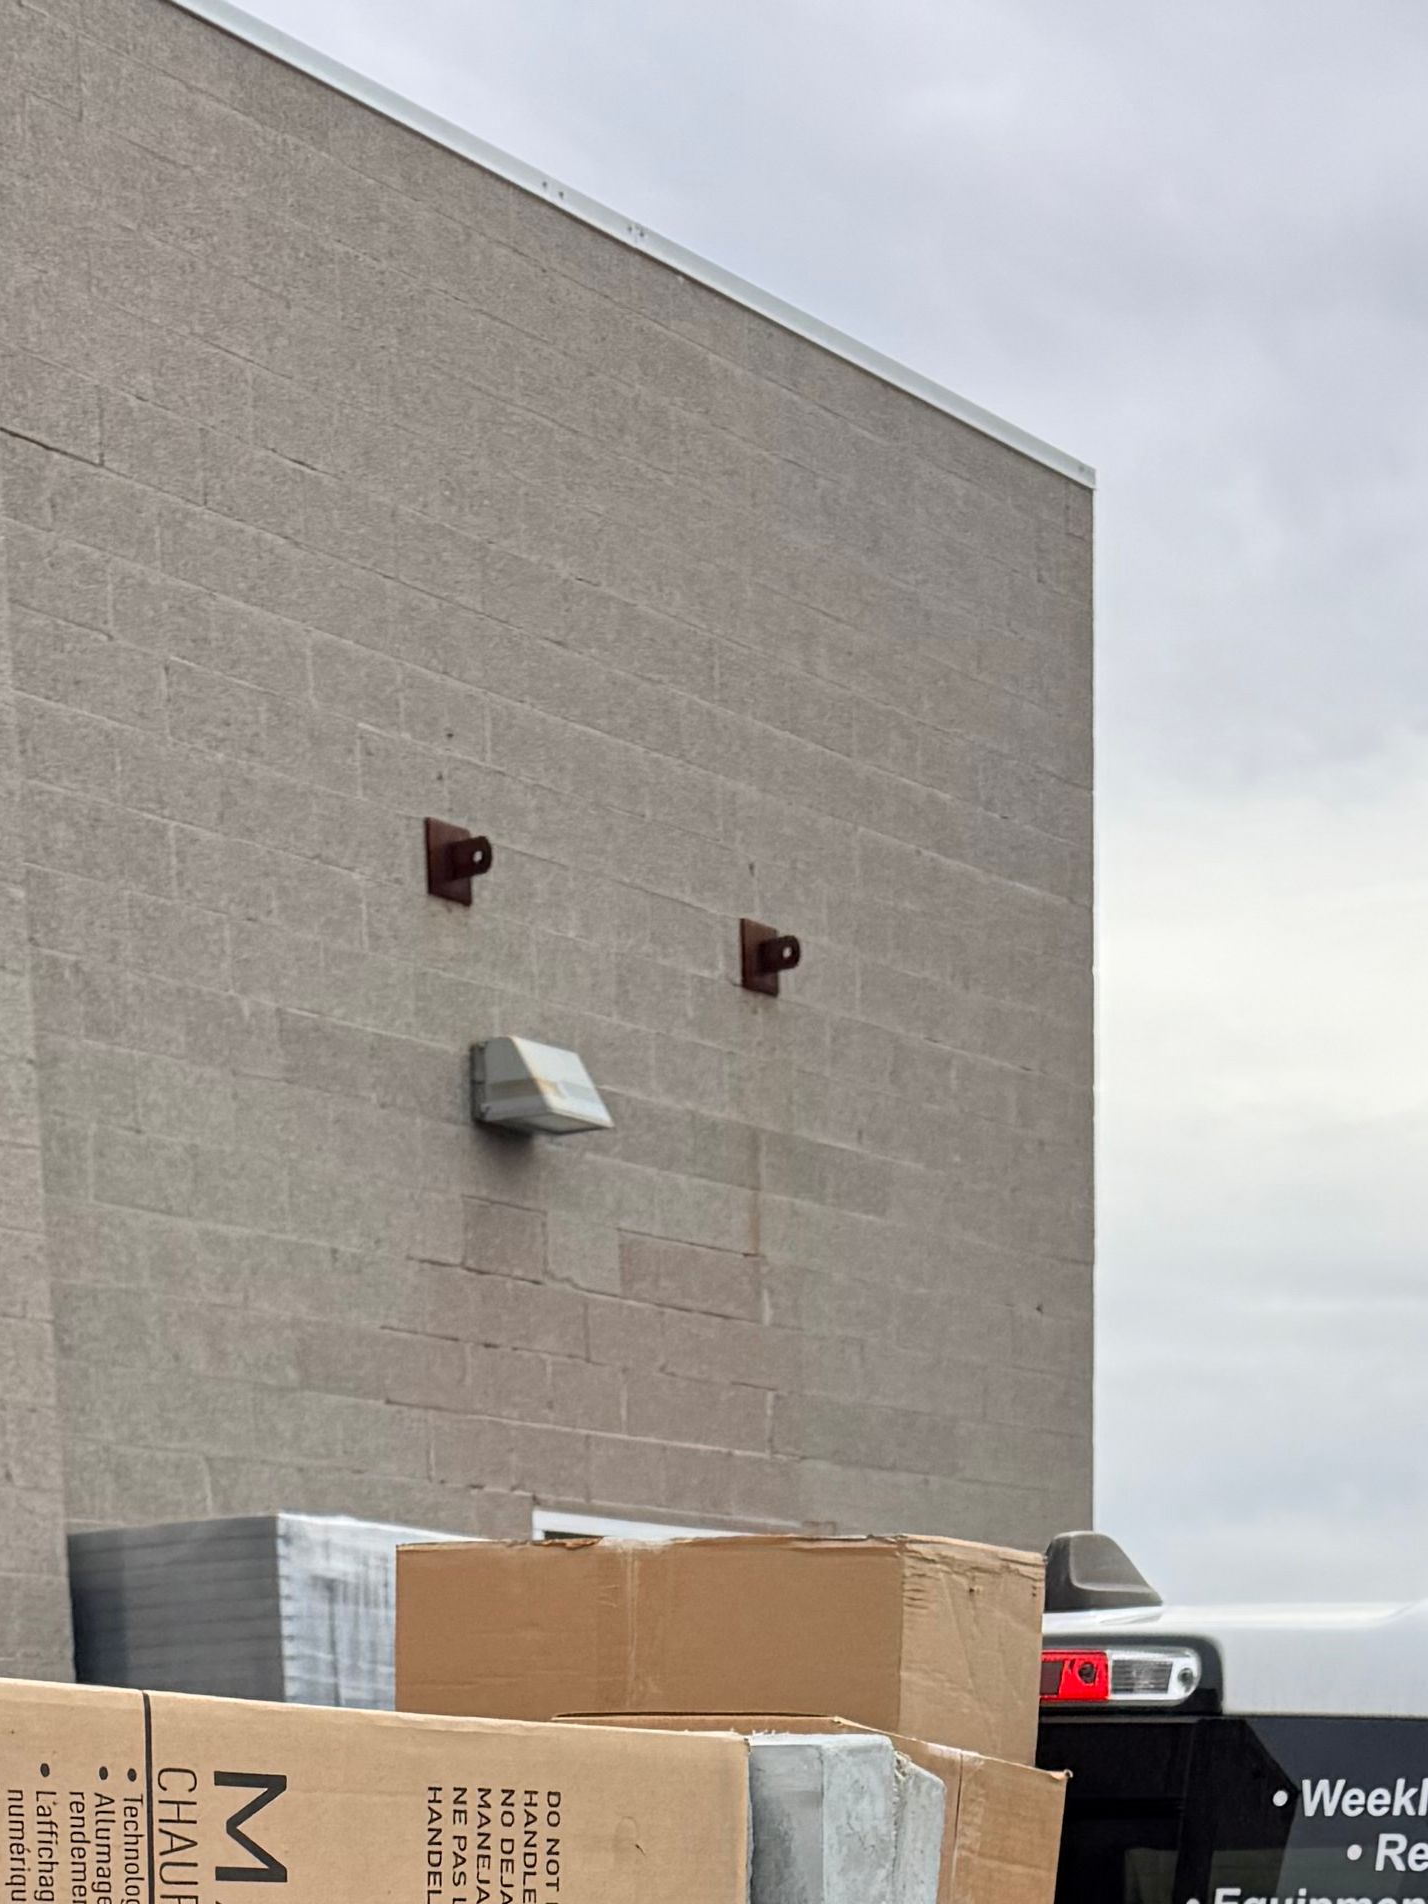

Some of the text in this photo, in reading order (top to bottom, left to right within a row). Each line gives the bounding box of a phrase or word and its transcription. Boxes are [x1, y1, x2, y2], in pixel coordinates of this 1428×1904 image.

[453, 1787, 467, 1825] NE
[501, 1789, 515, 1827] NO
[547, 1791, 561, 1827] DO
[427, 1787, 442, 1904] HANDEL
[453, 1836, 467, 1886] PAS
[523, 1790, 538, 1903] HANDLE
[546, 1838, 560, 1892] NOT
